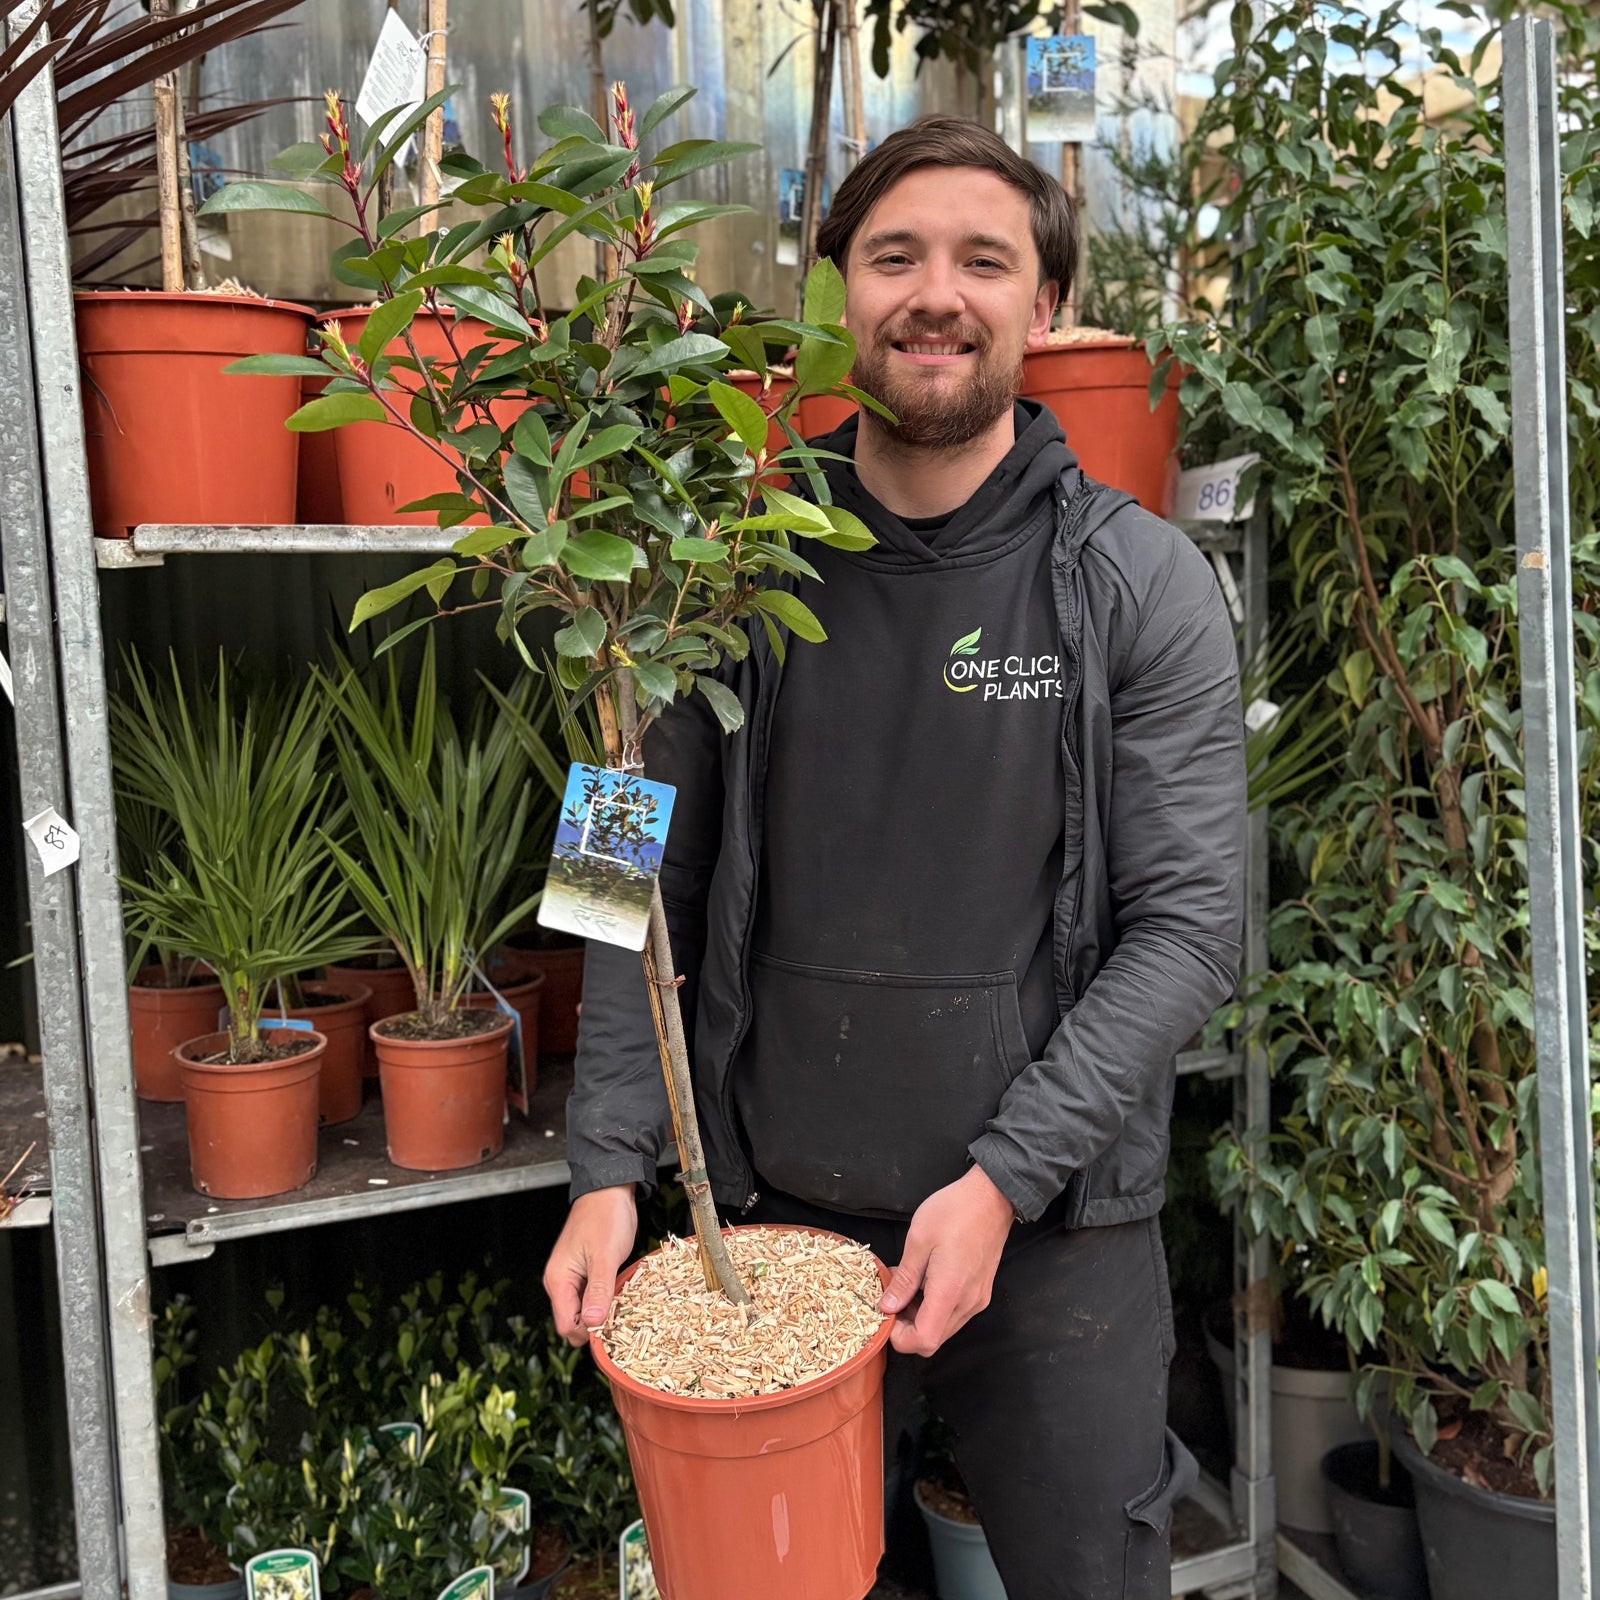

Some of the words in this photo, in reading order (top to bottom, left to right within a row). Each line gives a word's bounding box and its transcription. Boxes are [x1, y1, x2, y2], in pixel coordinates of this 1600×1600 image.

[1198, 479, 1230, 511] 86
[951, 659, 1001, 679] ONE
[983, 679, 1064, 702] PLANTS
